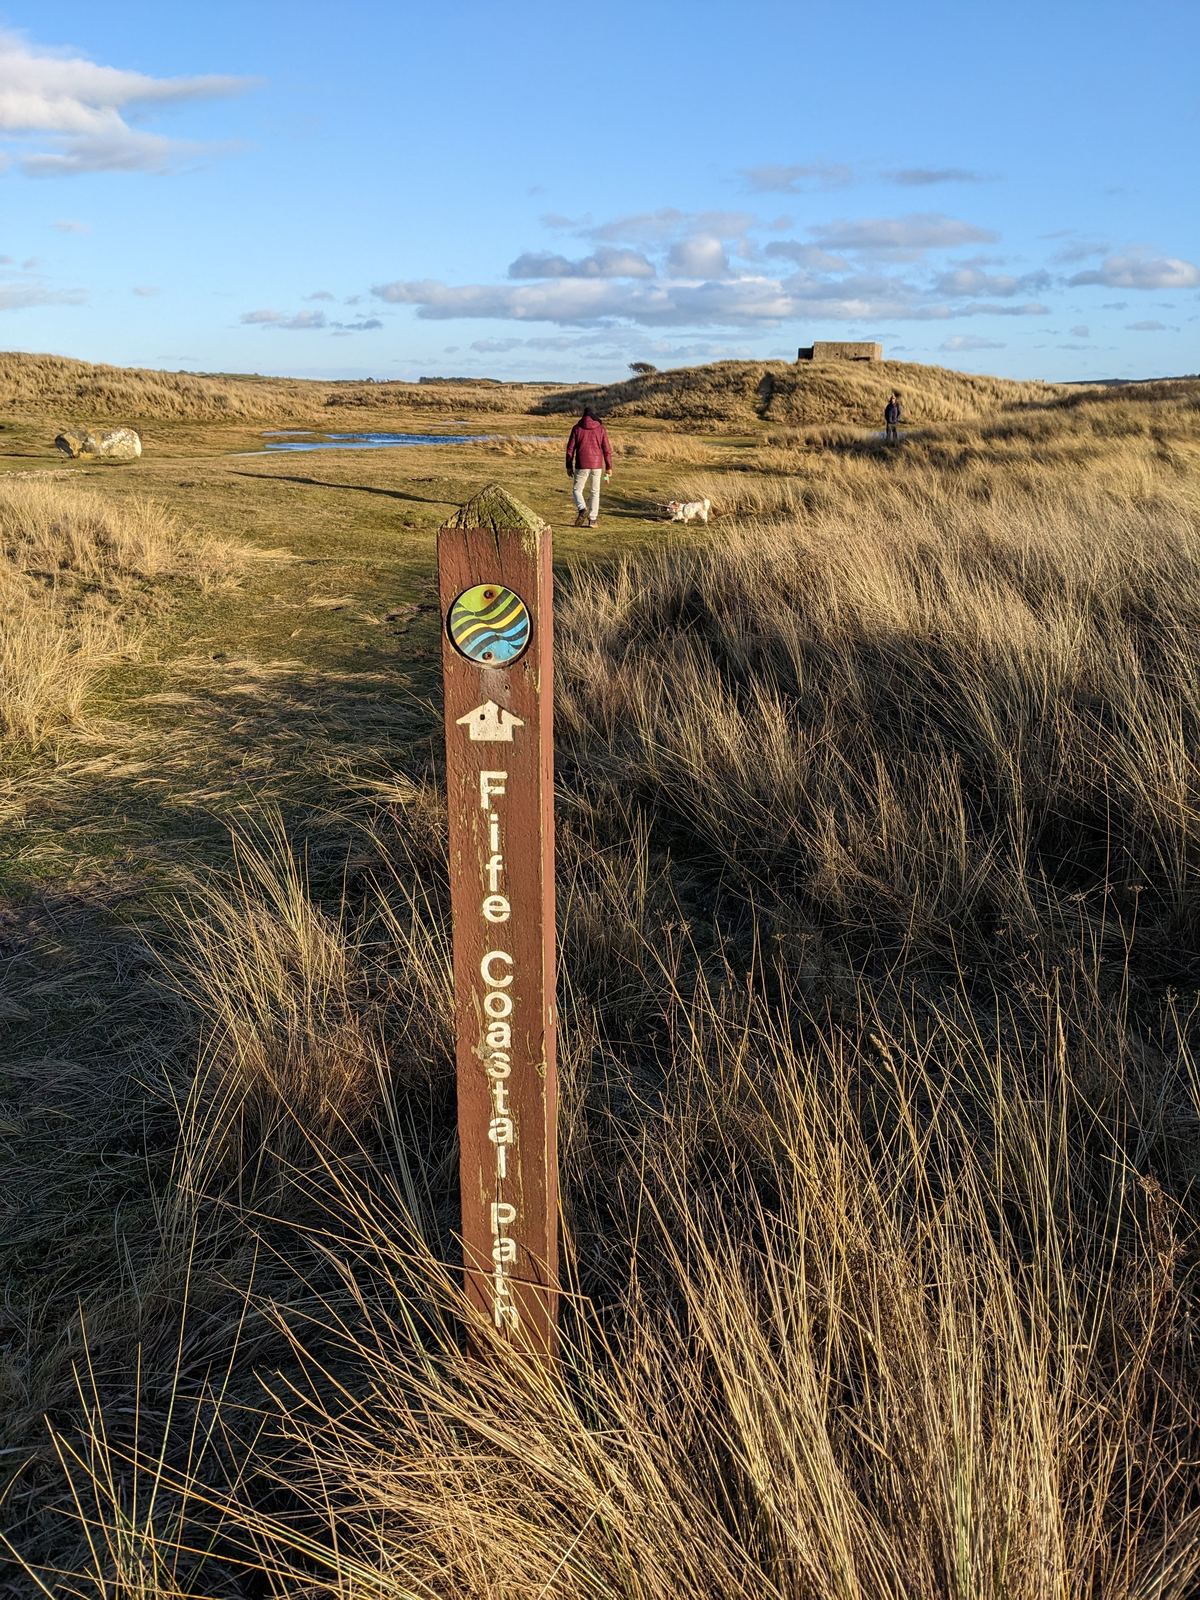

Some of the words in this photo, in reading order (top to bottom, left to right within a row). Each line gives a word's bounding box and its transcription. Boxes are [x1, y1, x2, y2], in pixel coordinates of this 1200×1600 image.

[480, 770, 511, 923] Fife
[480, 950, 514, 1178] Coastal
[490, 1202, 519, 1329] Path
